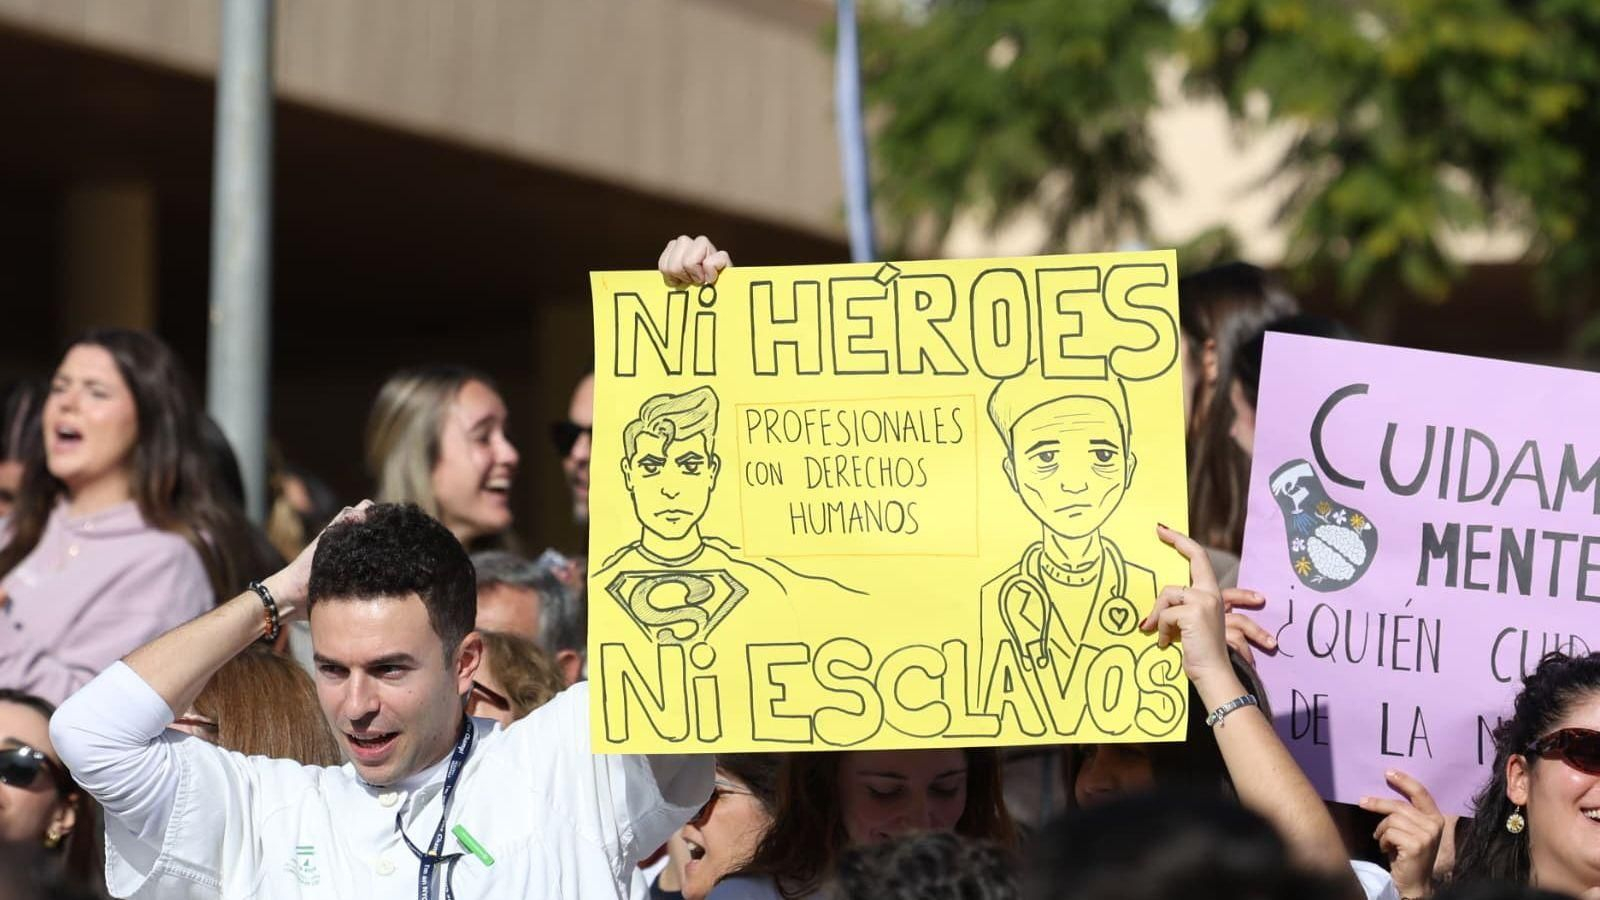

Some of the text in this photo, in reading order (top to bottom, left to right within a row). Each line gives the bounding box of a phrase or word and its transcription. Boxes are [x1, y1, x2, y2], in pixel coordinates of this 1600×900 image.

[750, 262, 1180, 381] HÉROES
[746, 407, 964, 446] PROFESIONALES
[745, 455, 928, 490] CON DERECHOS
[790, 500, 919, 535] HUMANOS
[1416, 522, 1600, 603] MENTE
[1275, 585, 1441, 674] ¿QUIÉN
[745, 636, 1187, 747] ESCLAVOS
[1291, 689, 1329, 746] DE
[1380, 702, 1433, 759] LA
